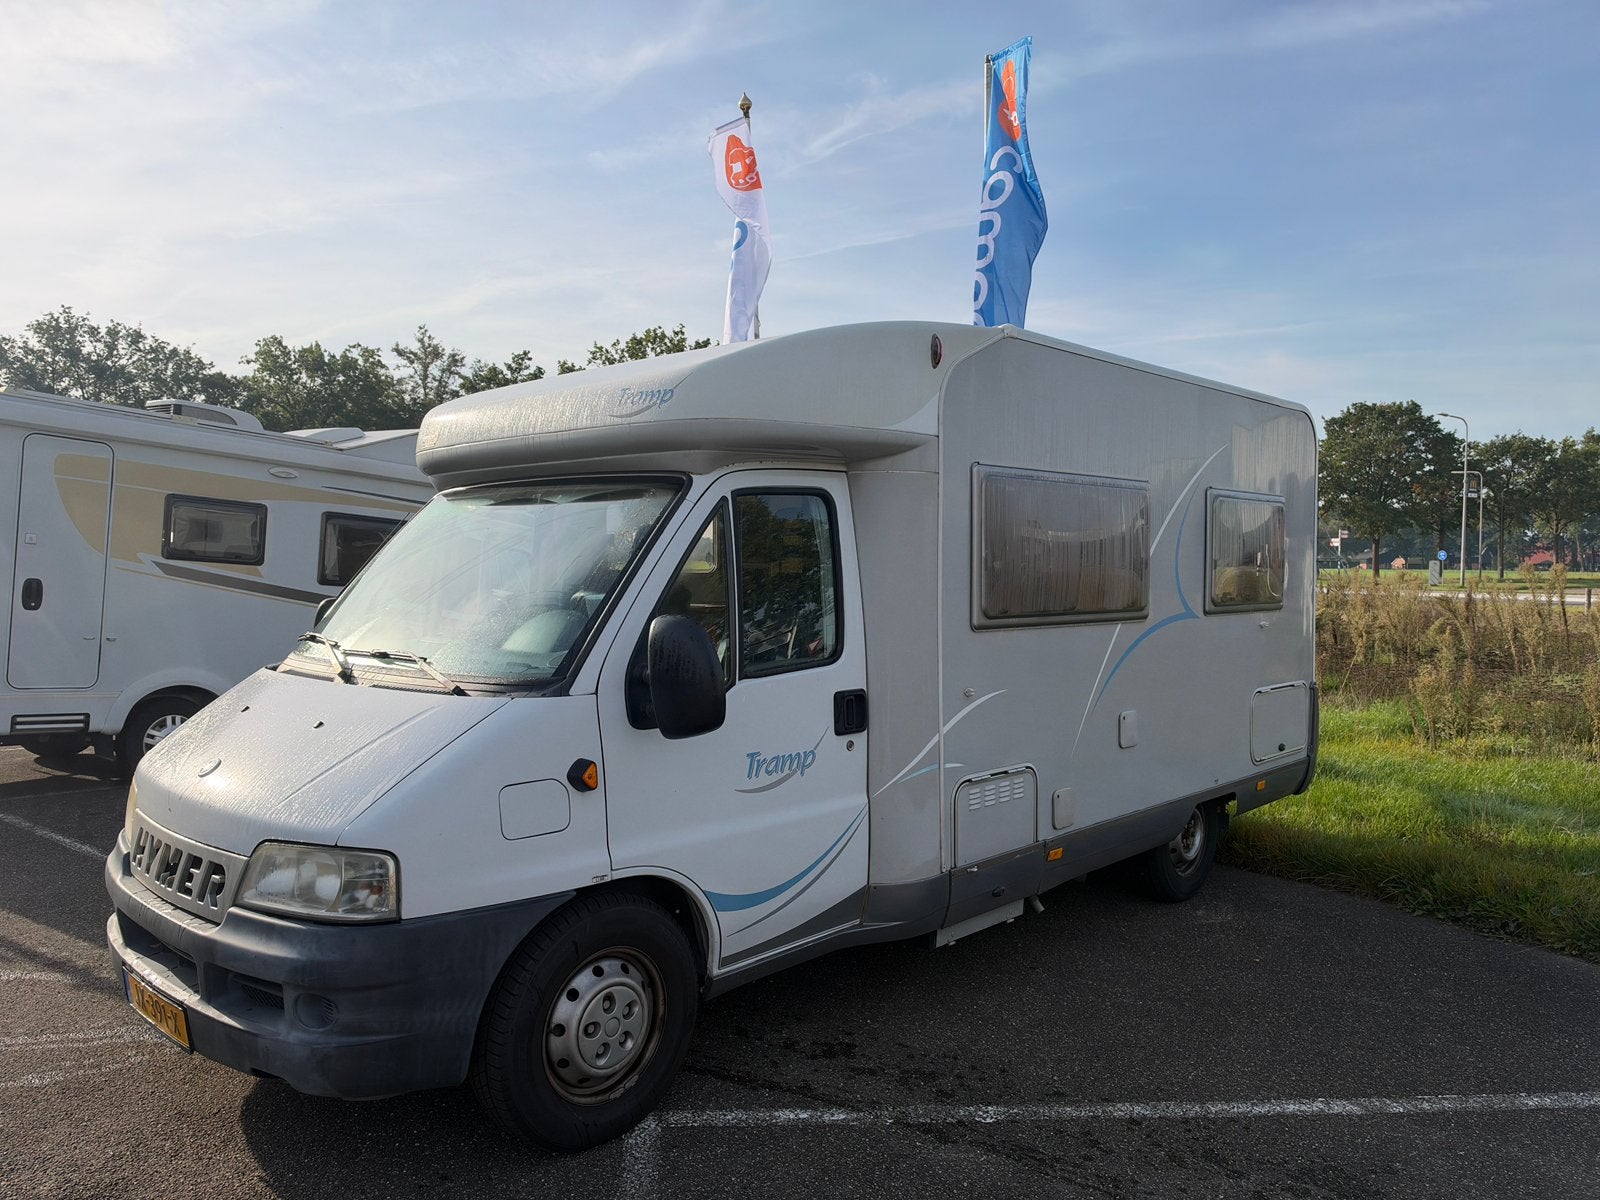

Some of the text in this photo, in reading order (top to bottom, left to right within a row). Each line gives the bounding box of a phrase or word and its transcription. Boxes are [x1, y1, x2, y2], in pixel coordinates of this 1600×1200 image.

[617, 386, 675, 409] Tramp
[745, 749, 817, 780] Tramp
[131, 826, 227, 910] HYMER
